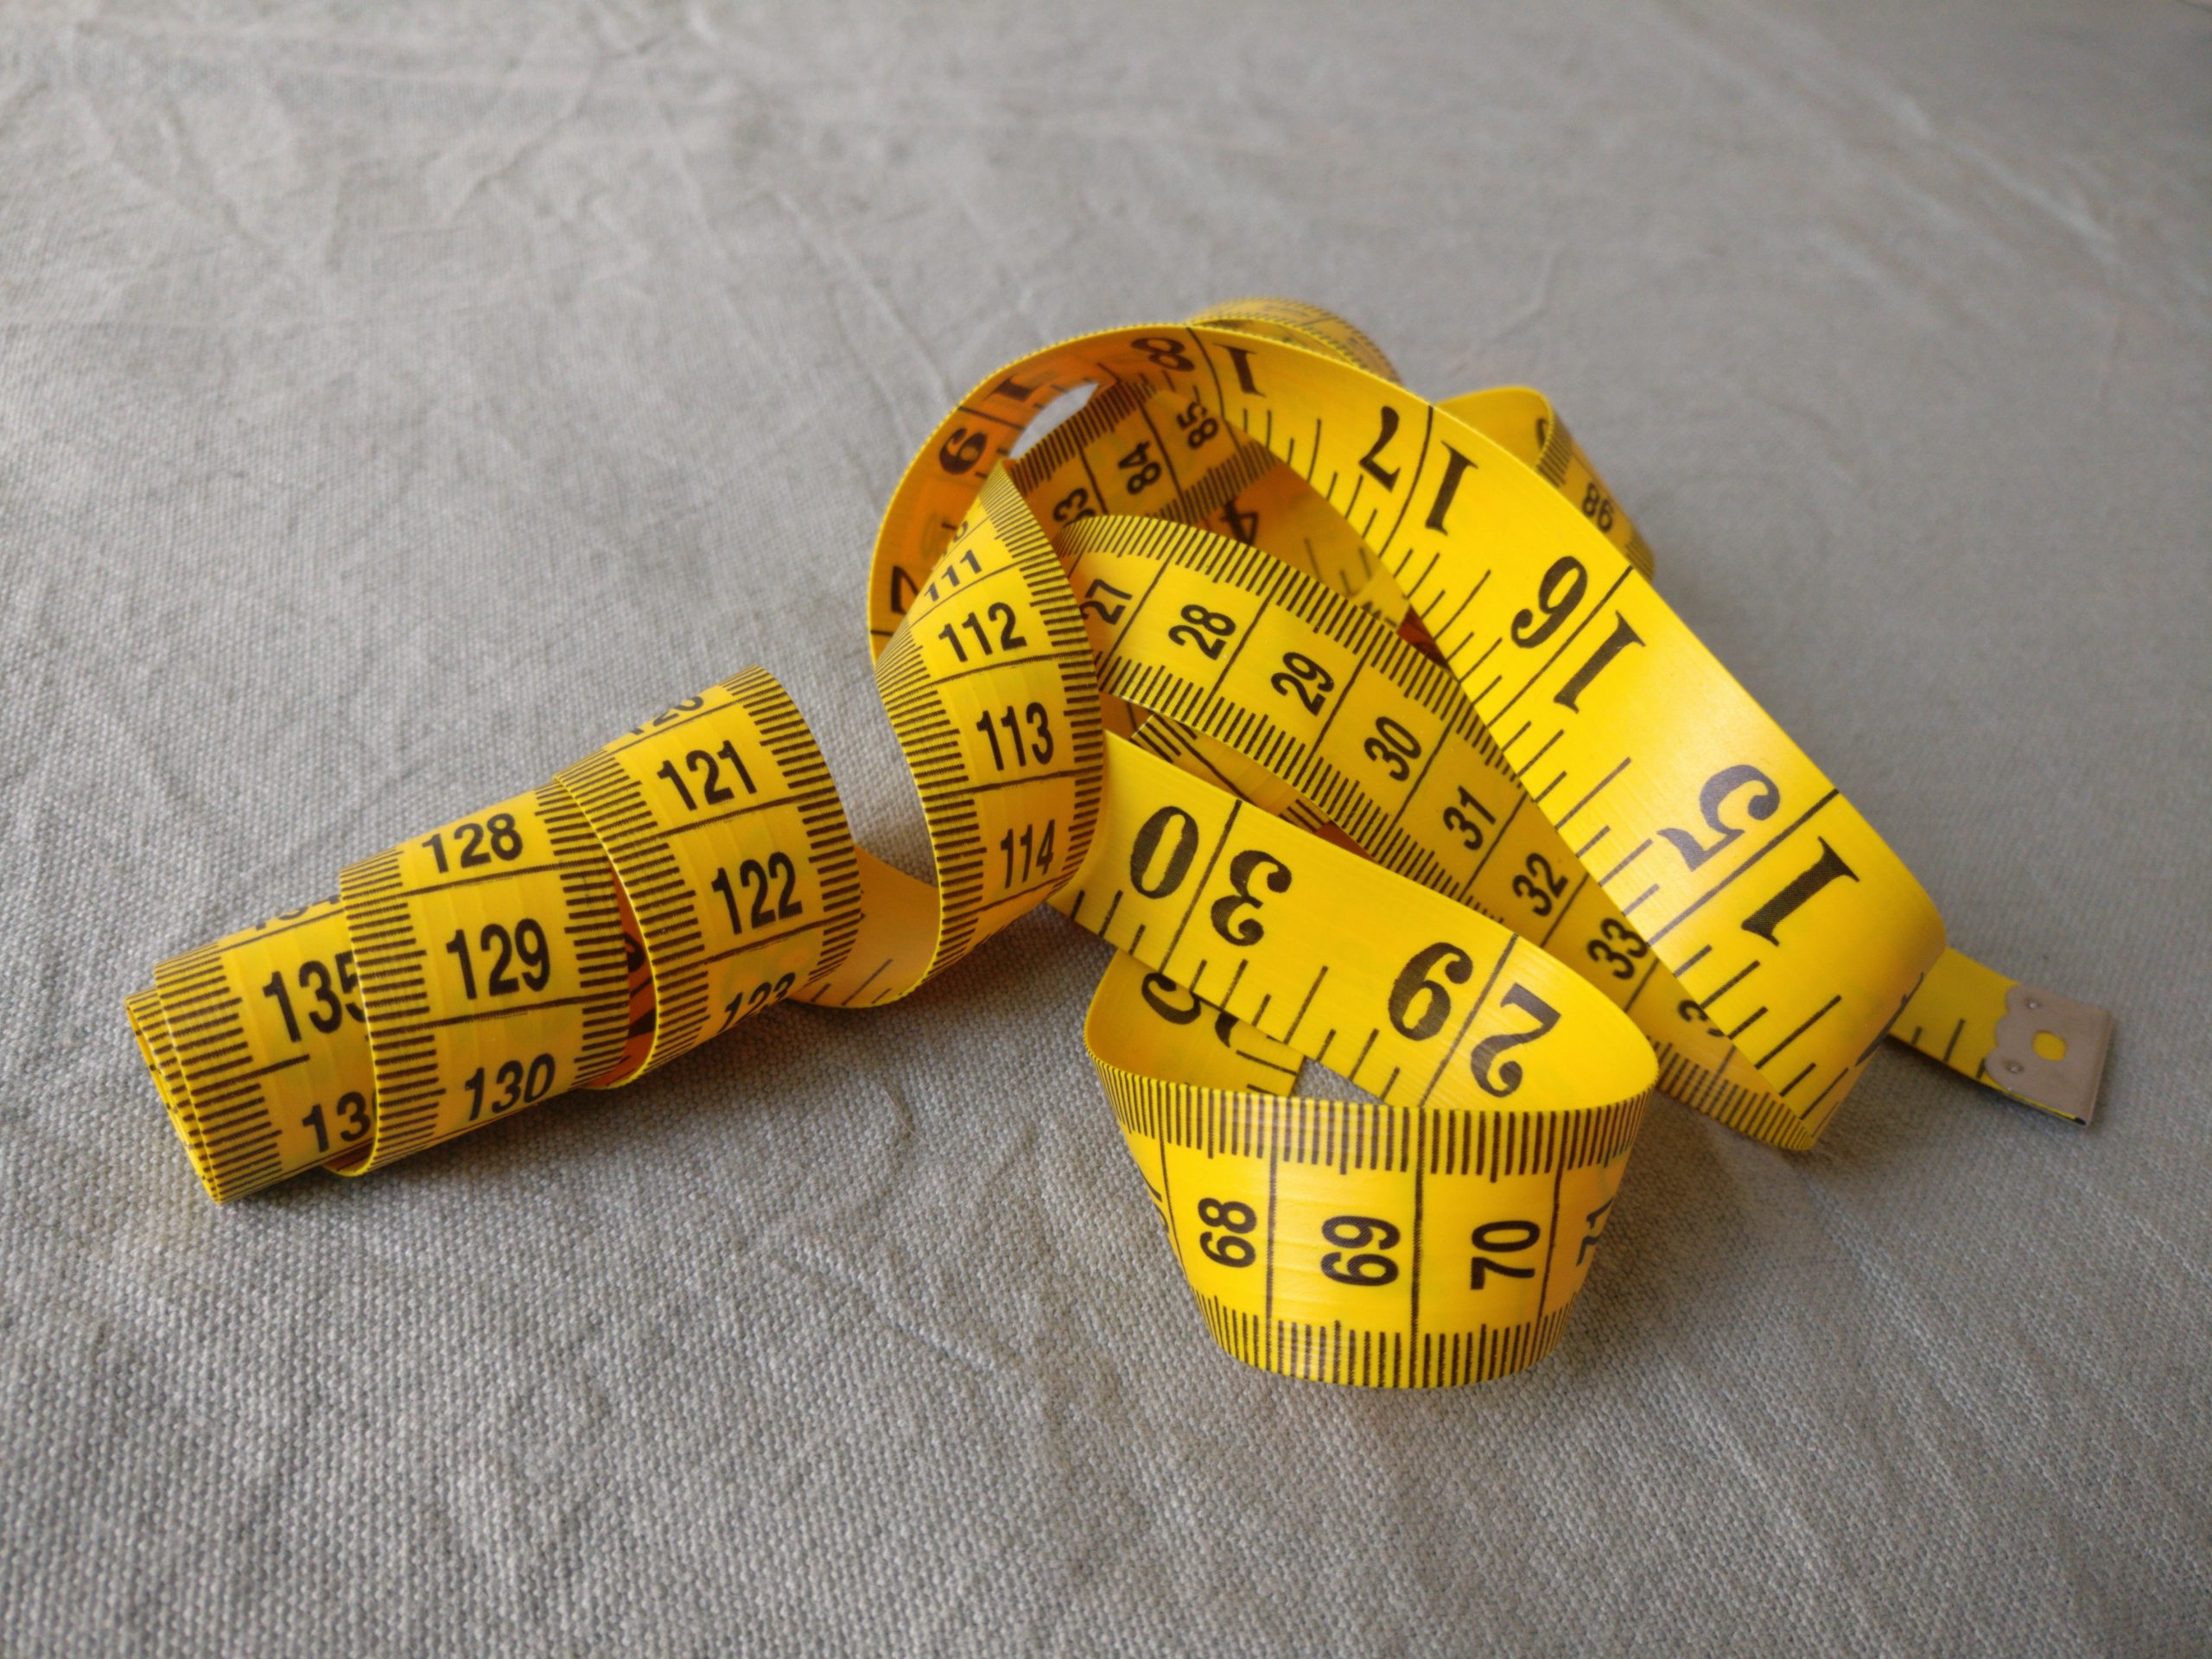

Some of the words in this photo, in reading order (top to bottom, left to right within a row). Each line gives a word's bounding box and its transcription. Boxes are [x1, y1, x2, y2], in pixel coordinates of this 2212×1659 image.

[1176, 401, 1218, 449] 85
[1118, 441, 1161, 495] 84
[1053, 488, 1096, 529] 3
[924, 549, 982, 602] 111
[1080, 579, 1133, 625] 27
[938, 602, 1027, 663] 112
[1168, 604, 1236, 660] 28
[1271, 652, 1335, 716] 29
[976, 702, 1054, 771] 113
[1364, 716, 1422, 782] 30
[657, 740, 757, 810] 121
[423, 813, 523, 873] 128
[1443, 785, 1497, 851] 31
[1000, 820, 1055, 888] 114
[1512, 853, 1568, 918] 32
[711, 852, 803, 934] 122
[447, 919, 550, 1001] 129
[1586, 918, 1648, 981] 33
[465, 1052, 556, 1122] 130
[302, 1091, 377, 1153] 13
[1198, 1197, 1257, 1268] 68
[1320, 1215, 1400, 1287] 69
[1471, 1219, 1541, 1290] 70
